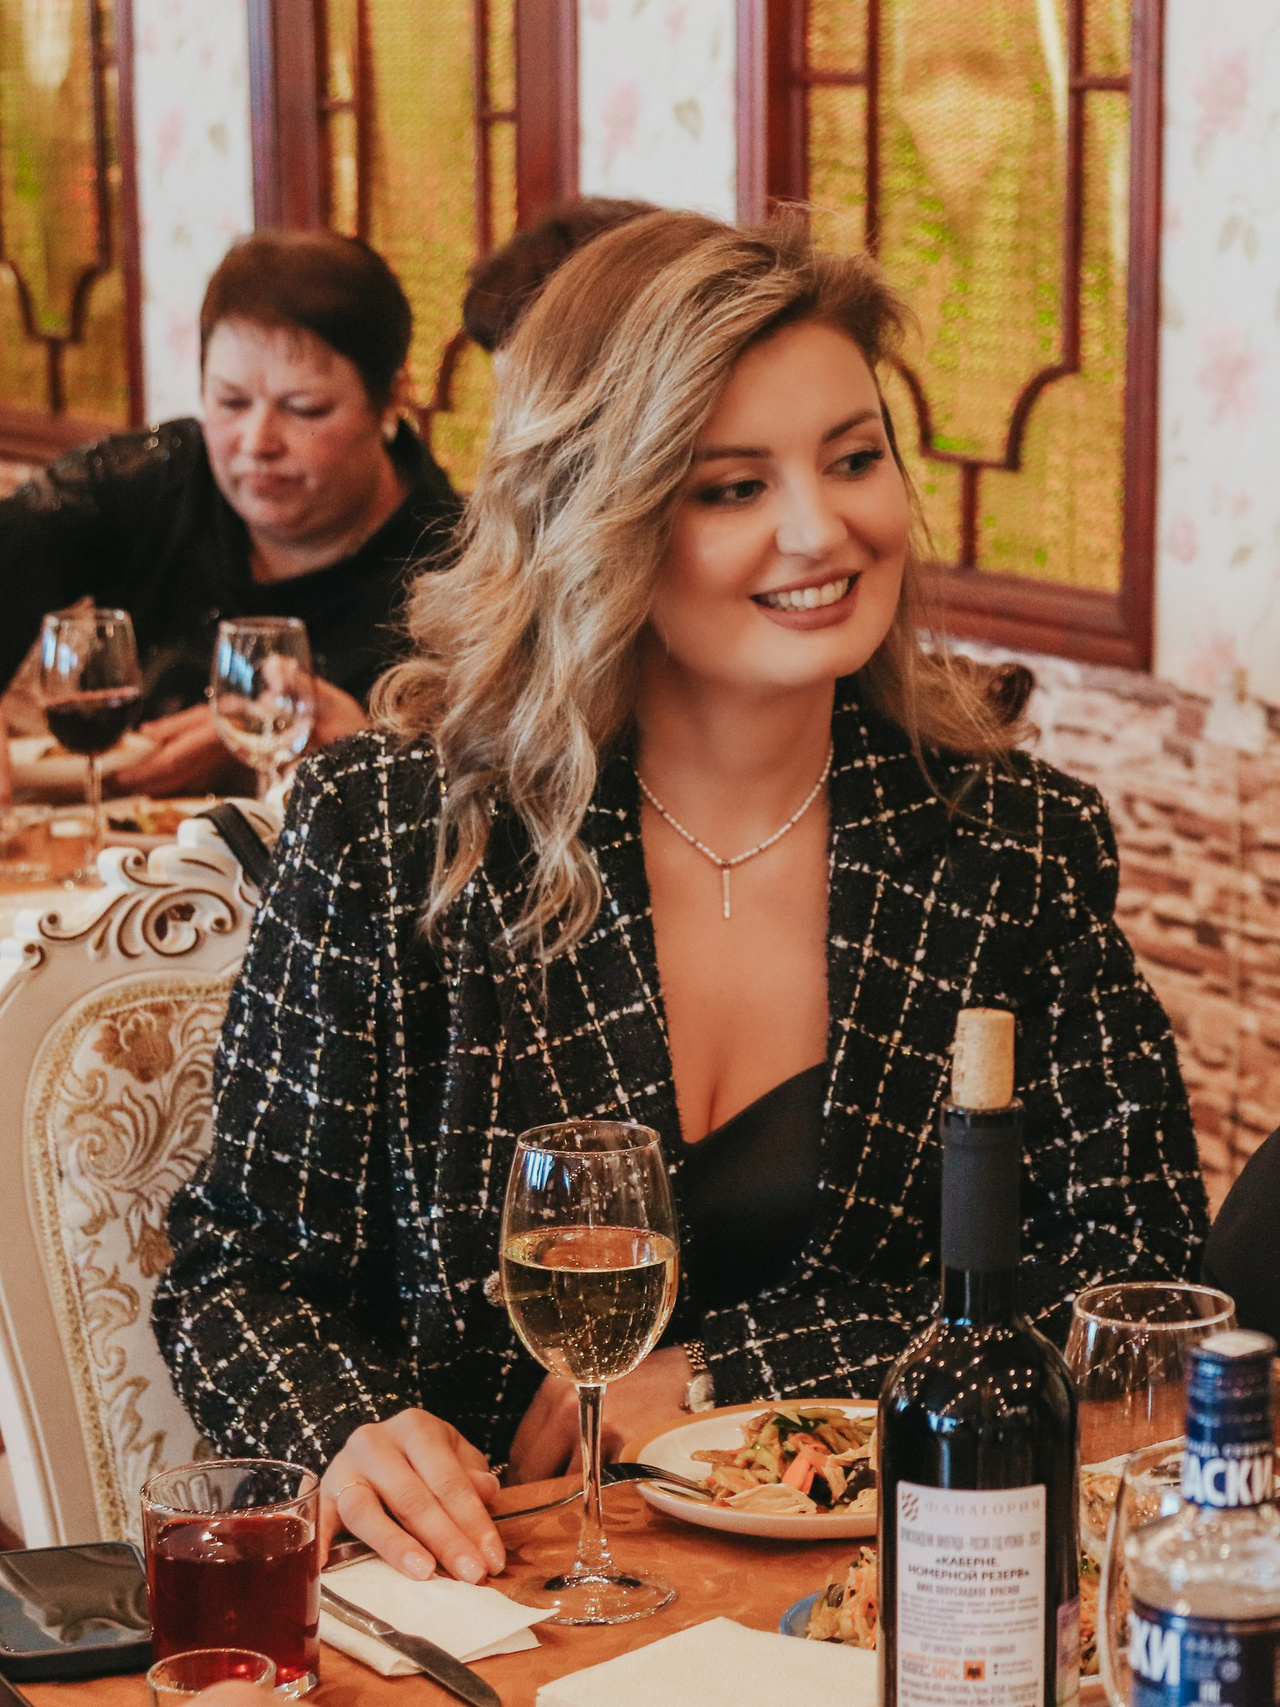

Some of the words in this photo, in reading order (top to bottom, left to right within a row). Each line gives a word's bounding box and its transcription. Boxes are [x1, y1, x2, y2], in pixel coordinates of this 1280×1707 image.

[1181, 1453, 1273, 1508] АСКИ
[908, 1564, 978, 1582] НОМЕРНОЙ
[1127, 1612, 1181, 1686] КИ
